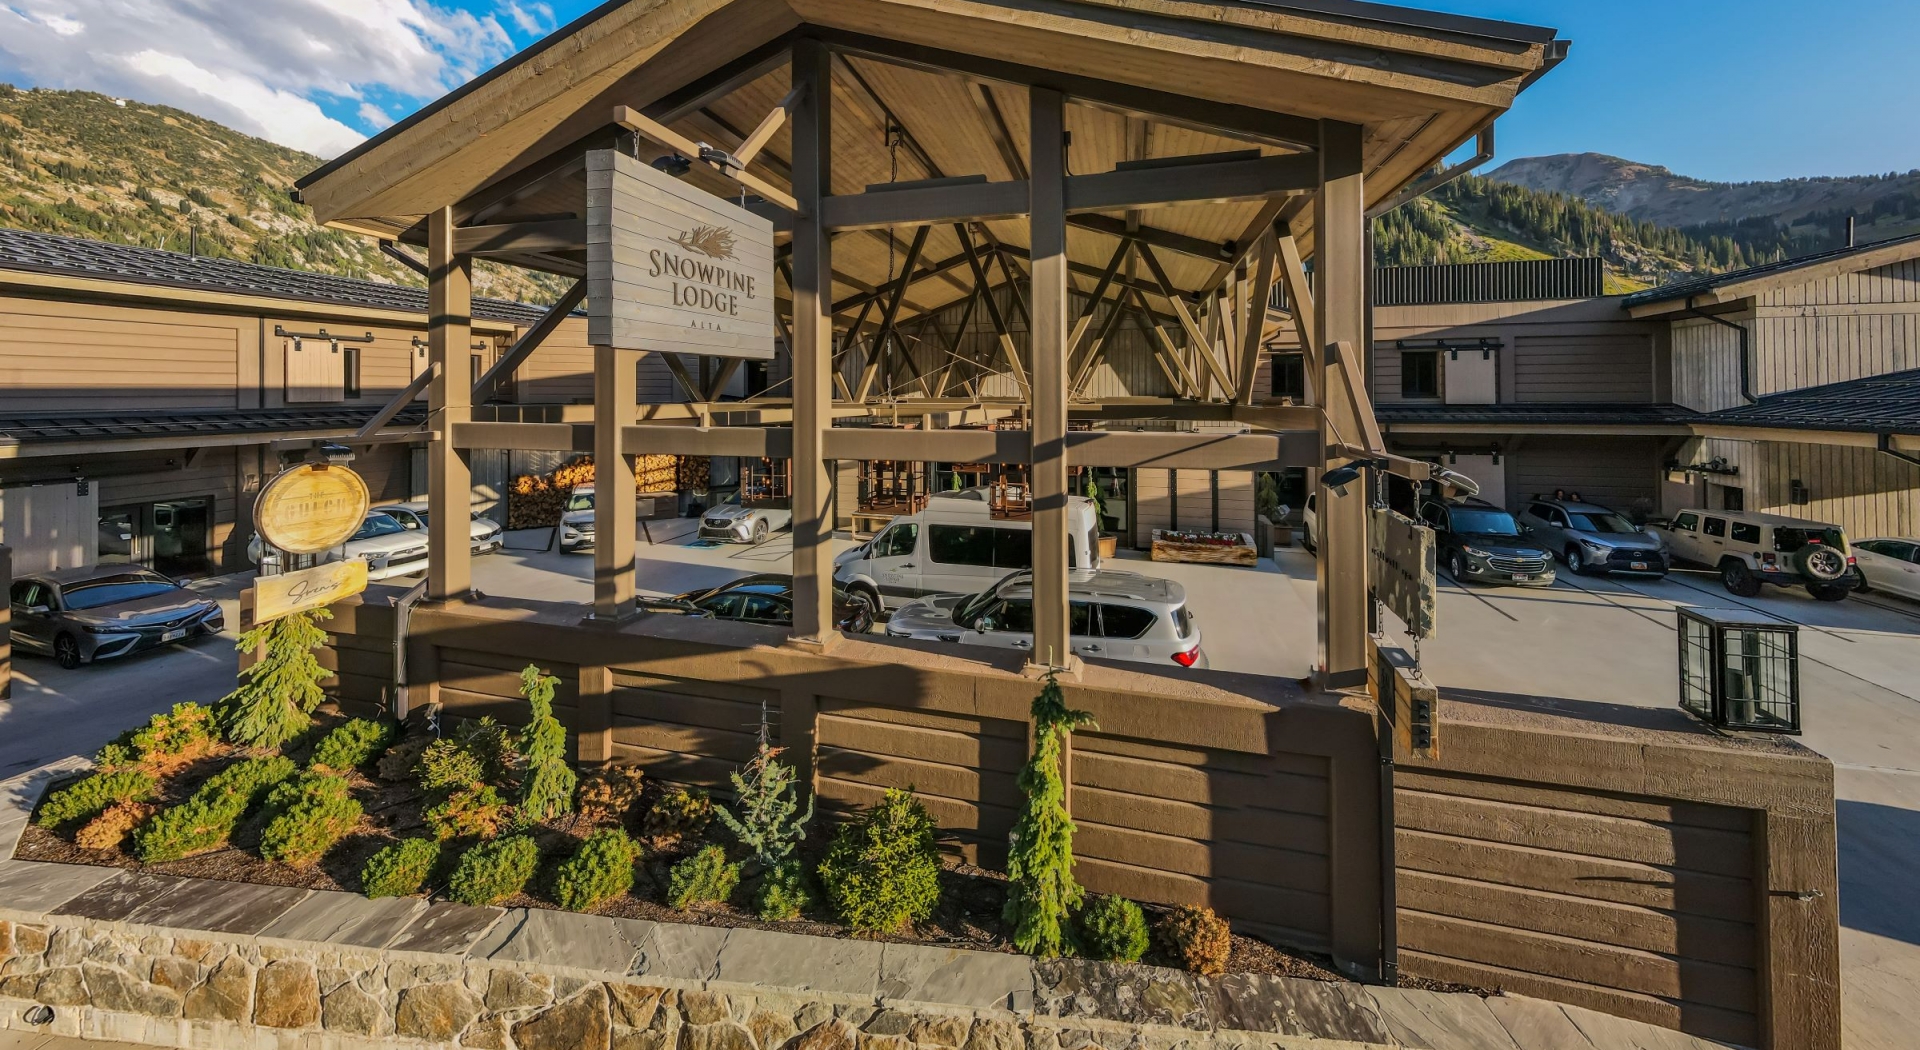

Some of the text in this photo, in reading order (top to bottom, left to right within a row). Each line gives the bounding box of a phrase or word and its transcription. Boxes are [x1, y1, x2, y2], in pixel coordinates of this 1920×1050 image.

[649, 249, 756, 299] SNOWPINE
[672, 282, 738, 316] LODGE
[690, 319, 721, 331] ALTA
[309, 491, 325, 500] THE
